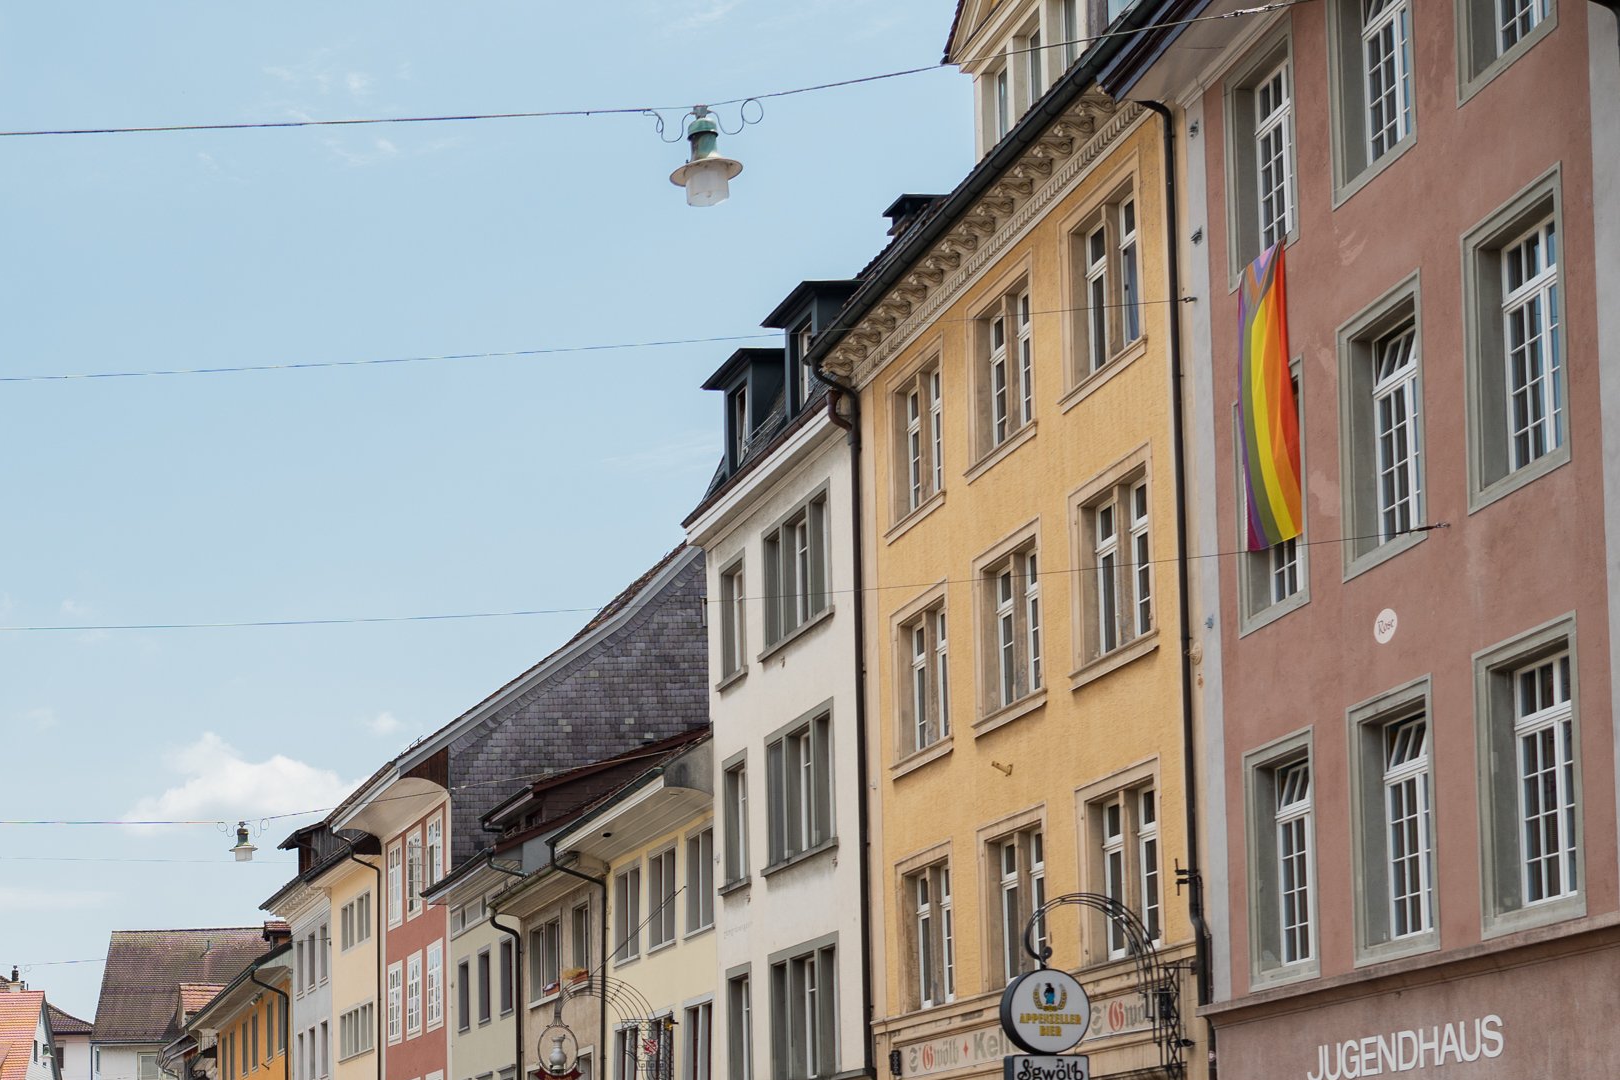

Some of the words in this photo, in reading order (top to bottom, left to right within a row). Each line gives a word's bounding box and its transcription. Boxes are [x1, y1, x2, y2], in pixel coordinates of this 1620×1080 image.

[1019, 1012, 1082, 1025] APPENZELLER
[1039, 1025, 1062, 1037] BIER
[973, 1027, 1020, 1060] Kell
